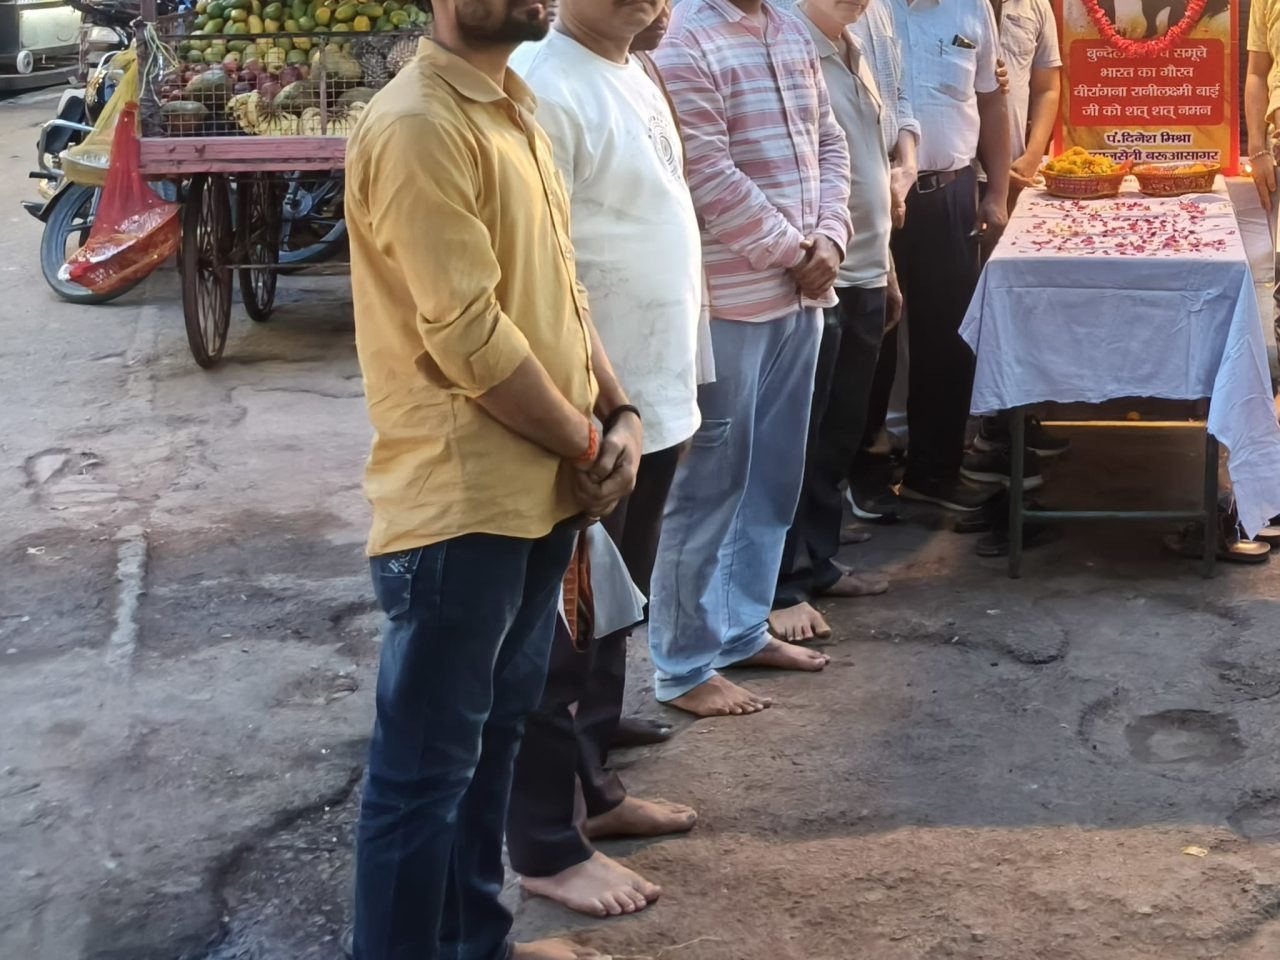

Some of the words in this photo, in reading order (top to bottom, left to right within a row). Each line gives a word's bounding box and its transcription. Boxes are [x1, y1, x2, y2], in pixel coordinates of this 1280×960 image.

[1174, 45, 1208, 62] समूचे
[1100, 66, 1135, 78] भारत
[1138, 66, 1157, 78] का
[1160, 64, 1194, 78] गौरव
[1074, 83, 1128, 98] वीरांगना
[1196, 83, 1221, 99] बाई
[1082, 103, 1099, 117] जी
[1102, 103, 1122, 117] को
[1125, 105, 1150, 119] शत्
[1152, 105, 1177, 119] शत्
[1178, 105, 1212, 117] नमन
[1160, 131, 1192, 144] मिश्रा
